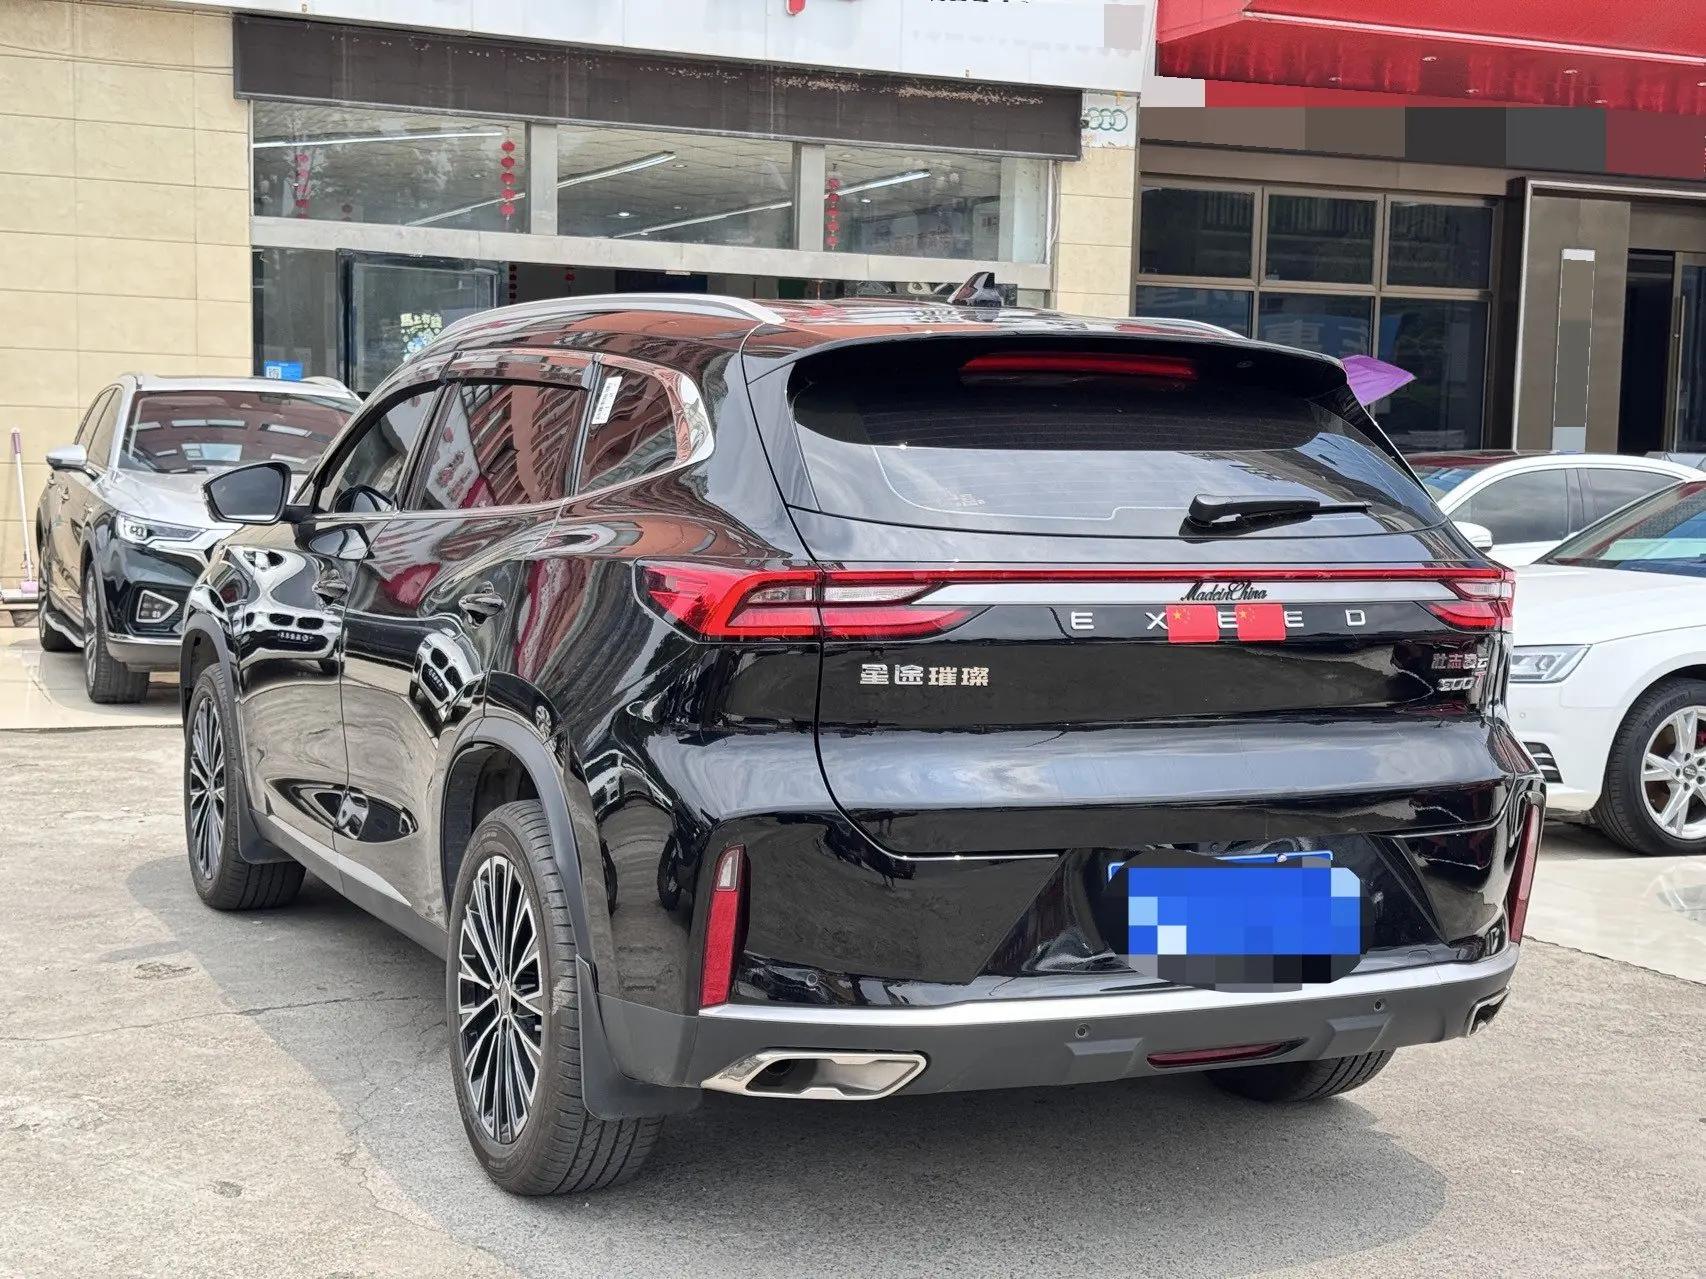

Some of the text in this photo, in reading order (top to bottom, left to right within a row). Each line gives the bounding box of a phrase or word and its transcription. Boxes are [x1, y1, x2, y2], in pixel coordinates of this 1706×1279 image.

[1070, 609, 1366, 630] EXEED
[860, 664, 989, 686] 星途璀璨
